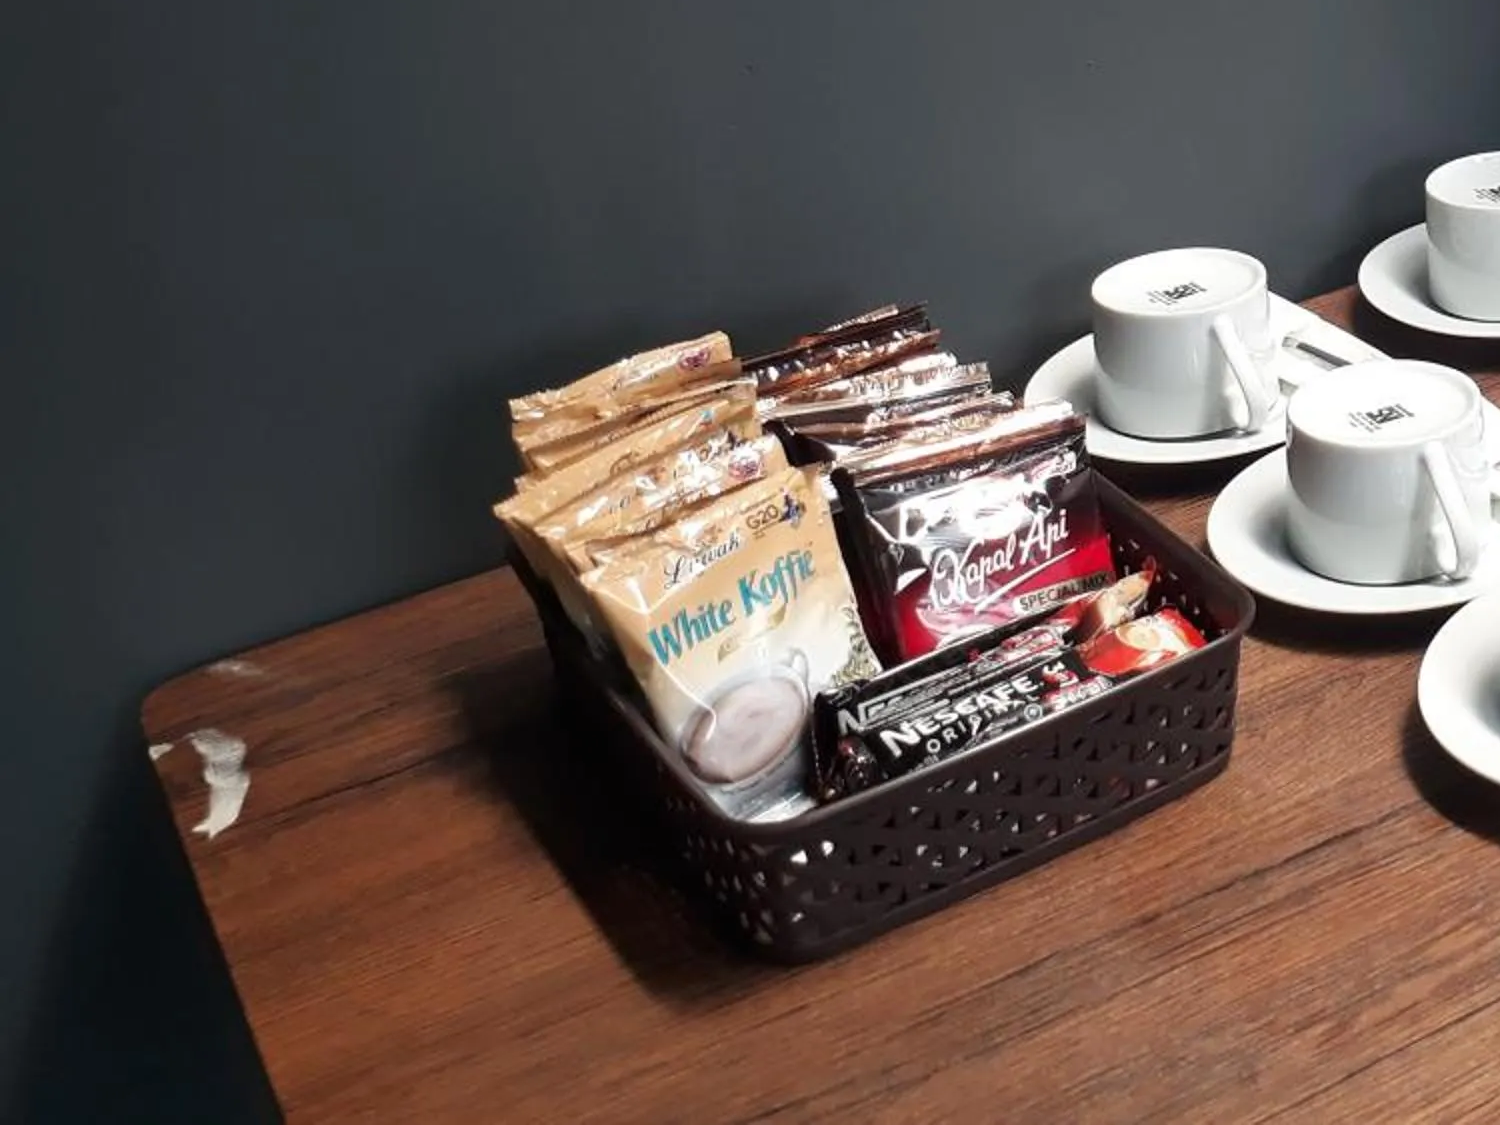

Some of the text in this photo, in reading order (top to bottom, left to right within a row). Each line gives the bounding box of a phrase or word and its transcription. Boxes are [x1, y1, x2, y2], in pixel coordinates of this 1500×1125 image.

[745, 504, 779, 529] G20
[1019, 505, 1069, 566] Api
[647, 547, 817, 667] White Koffie
